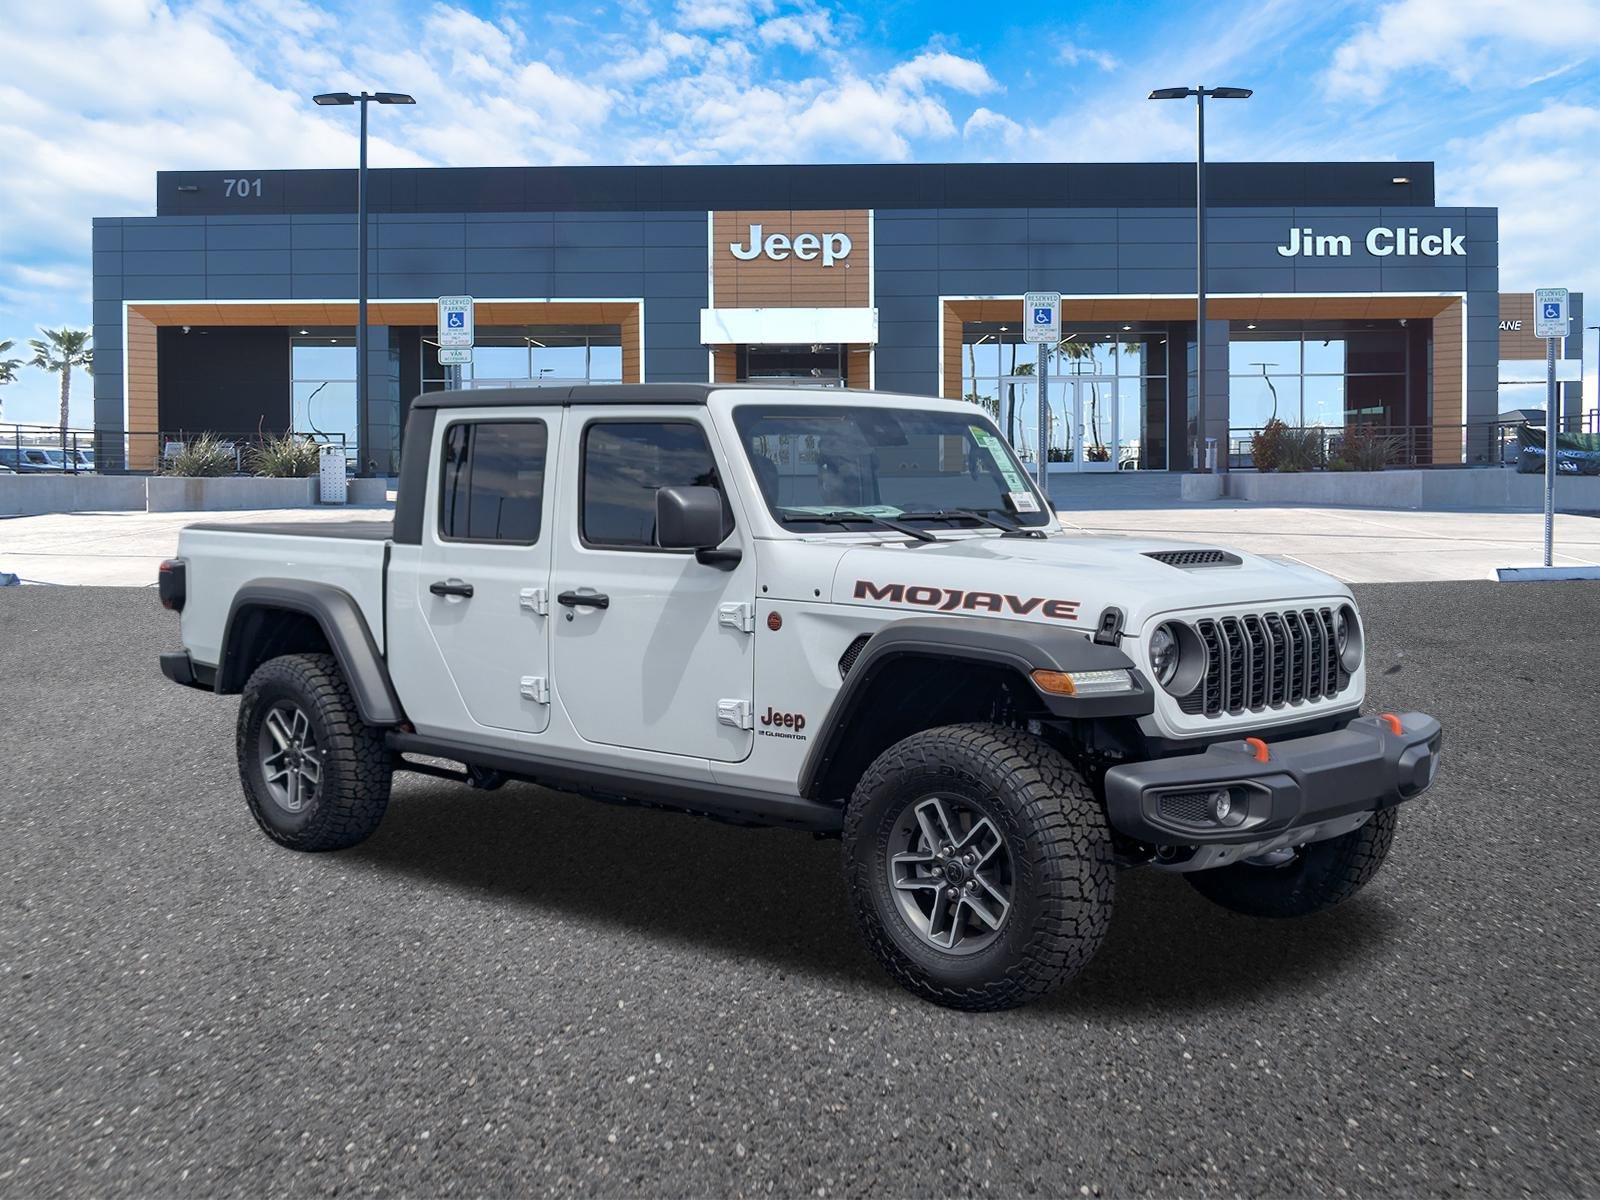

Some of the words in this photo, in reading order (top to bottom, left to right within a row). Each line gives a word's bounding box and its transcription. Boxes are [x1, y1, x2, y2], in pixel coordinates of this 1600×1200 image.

[223, 178, 262, 198] 701
[729, 224, 853, 268] Jeep
[1277, 227, 1352, 257] Jim
[1366, 226, 1468, 257] Click
[853, 580, 1081, 620] MOJAVE
[761, 706, 806, 733] Jeep
[765, 730, 807, 741] GLADIATOR
